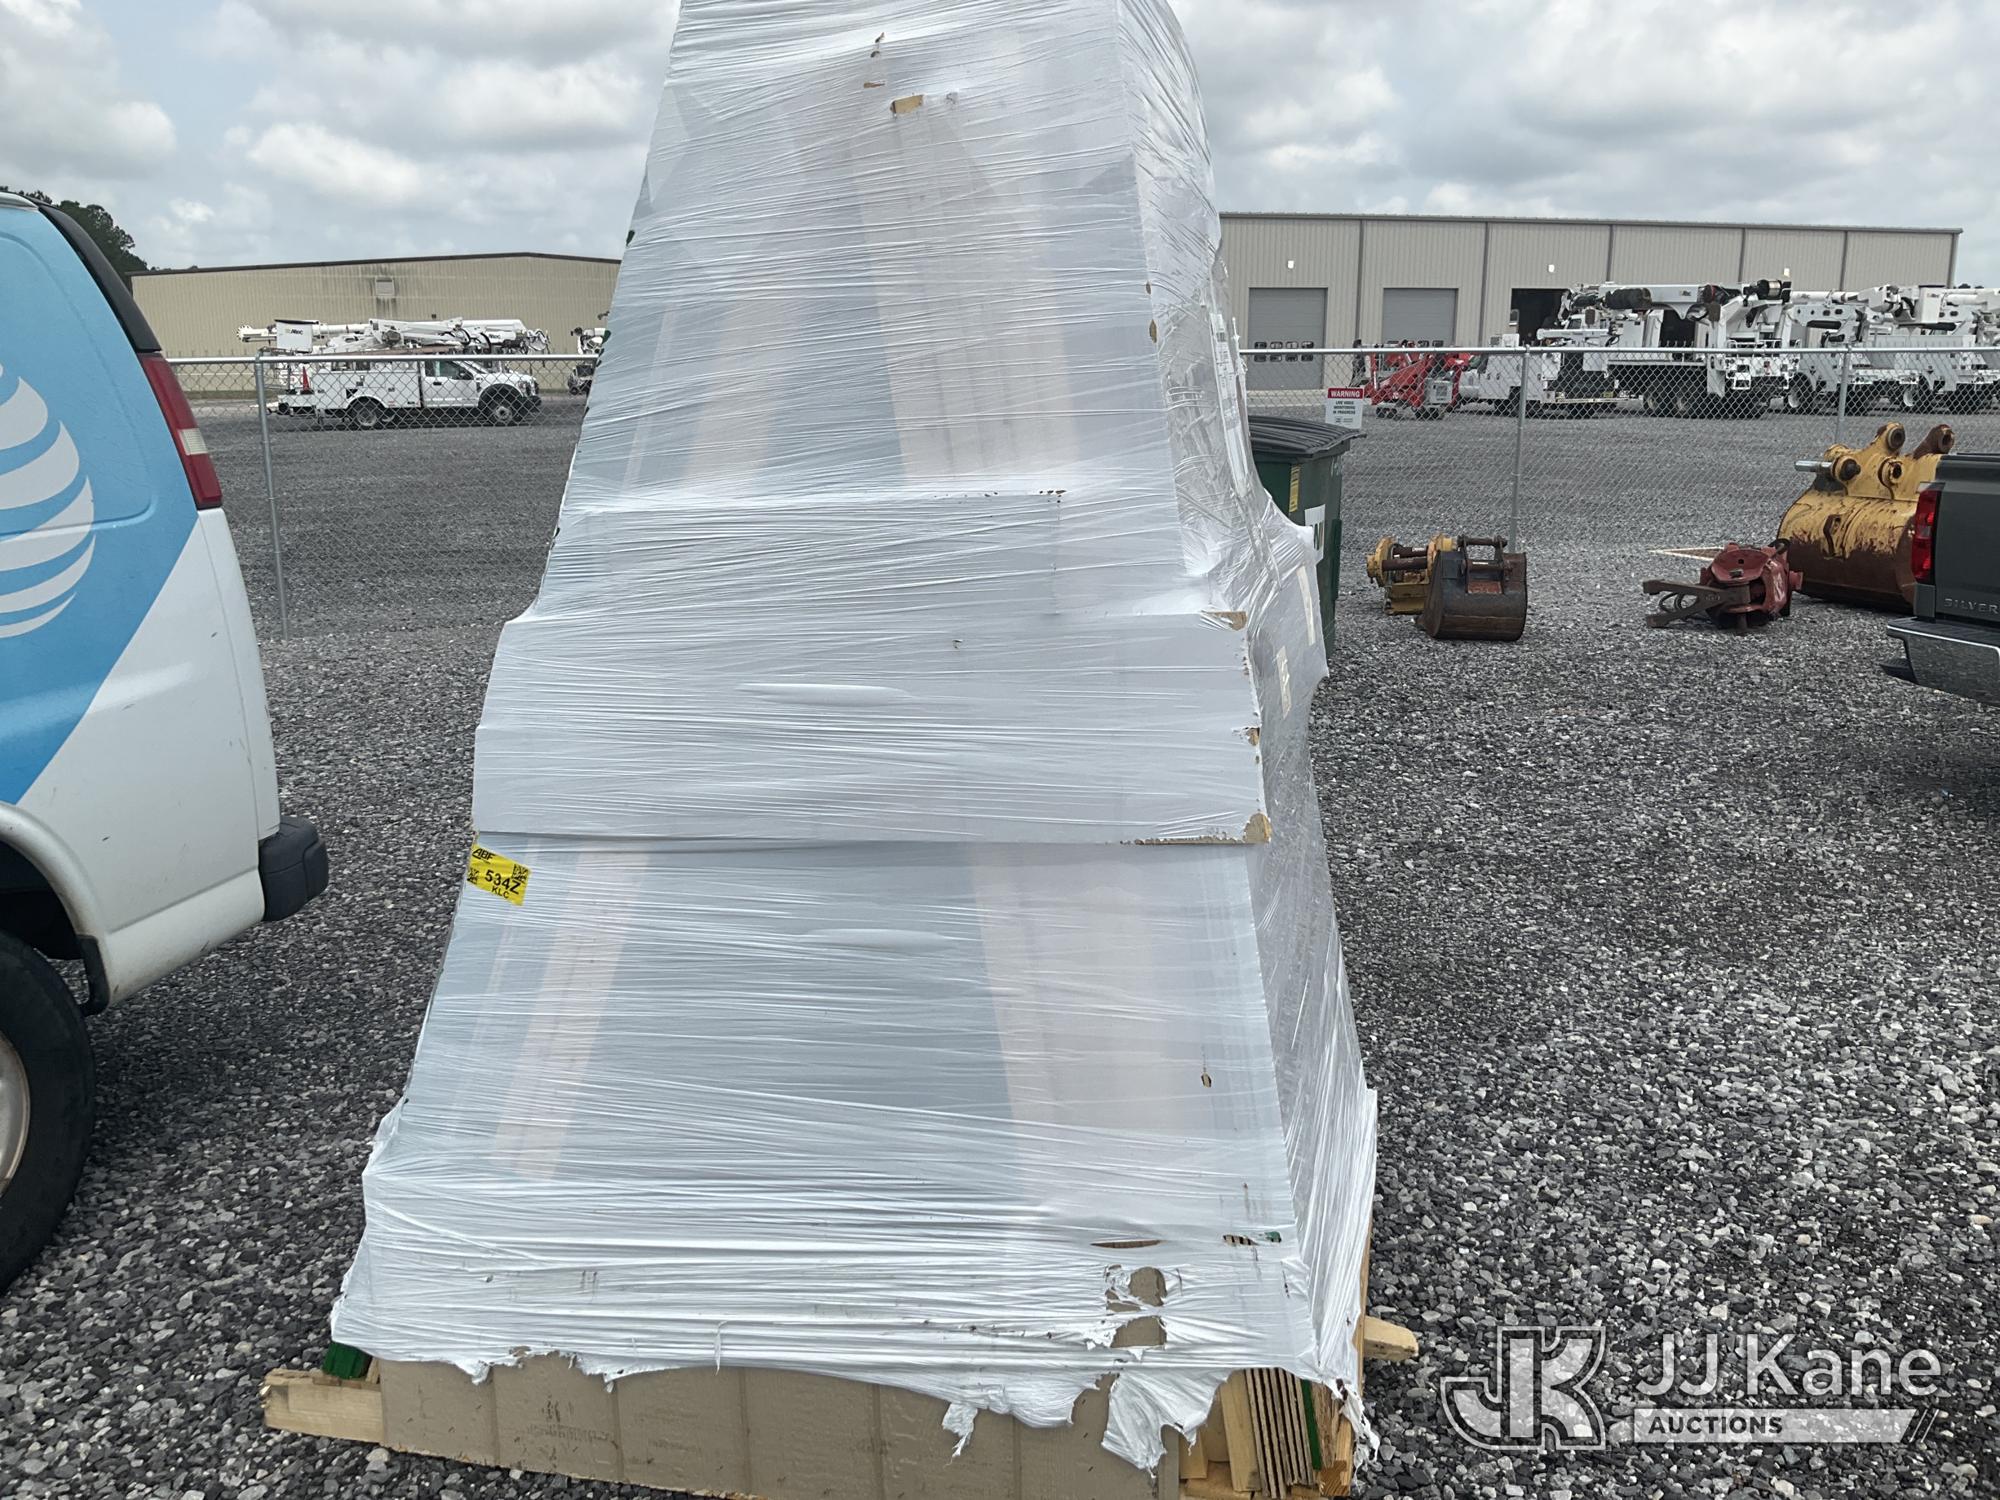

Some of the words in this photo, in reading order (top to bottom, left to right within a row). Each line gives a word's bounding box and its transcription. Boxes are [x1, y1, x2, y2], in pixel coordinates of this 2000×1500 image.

[1331, 390, 1360, 398] WARNING
[485, 869, 521, 895] 534Z
[491, 885, 510, 899] KLC
